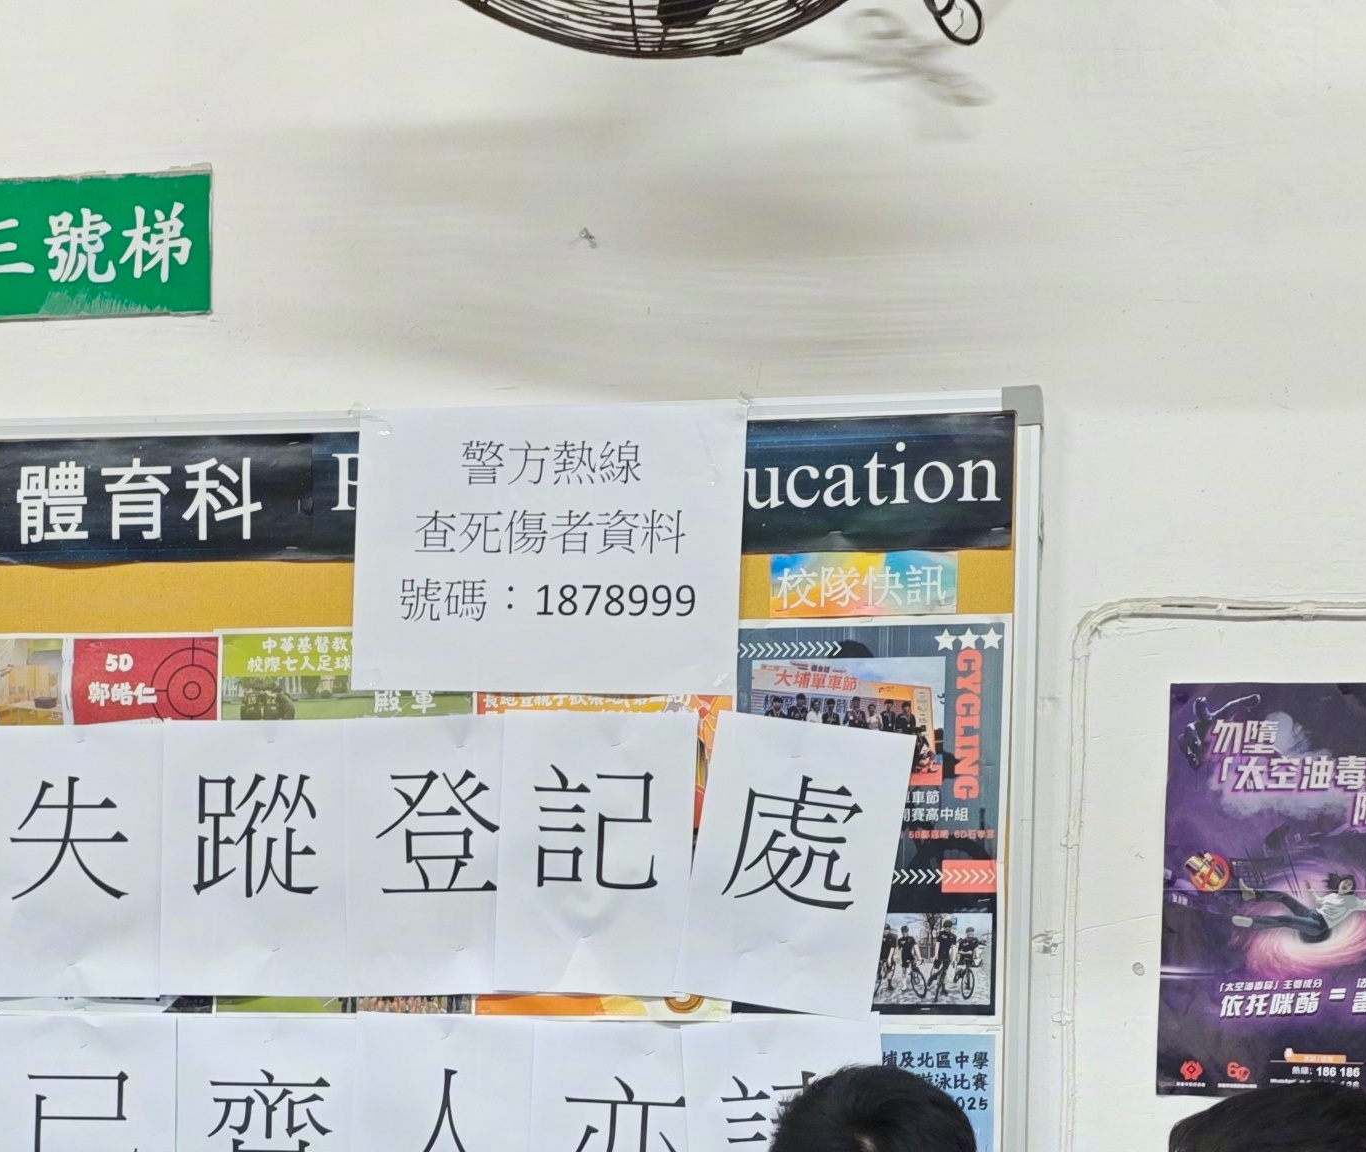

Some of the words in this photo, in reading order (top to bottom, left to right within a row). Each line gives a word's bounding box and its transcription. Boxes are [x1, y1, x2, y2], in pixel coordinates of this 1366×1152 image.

[461, 439, 643, 486] 警方熱線
[745, 441, 1002, 510] ucation
[16, 456, 263, 545] 體育科
[414, 508, 687, 556] 查死傷者資料
[777, 563, 947, 611] 校隊快訊
[105, 653, 133, 672] 5D
[262, 636, 353, 654] 中華基督教
[774, 669, 858, 691] 大埔單車節
[952, 649, 983, 800] CYCLING
[1211, 719, 1279, 755] 勿墮
[8, 764, 865, 913] 失蹤登記處
[1220, 991, 1321, 1018] 依托咪酯
[1316, 1066, 1336, 1077] 186
[1340, 1067, 1360, 1078] 186
[960, 1096, 989, 1111] 025
